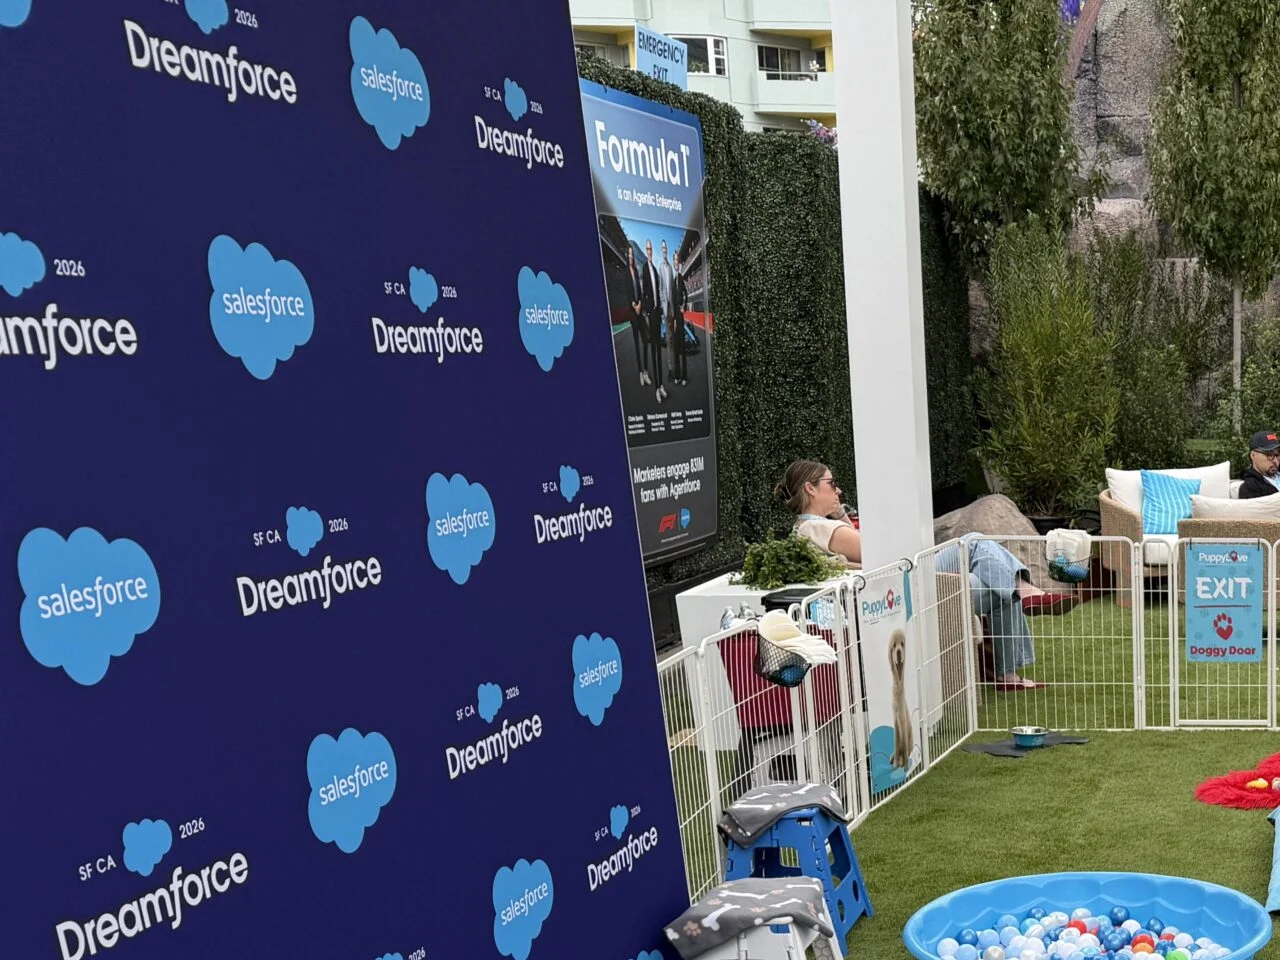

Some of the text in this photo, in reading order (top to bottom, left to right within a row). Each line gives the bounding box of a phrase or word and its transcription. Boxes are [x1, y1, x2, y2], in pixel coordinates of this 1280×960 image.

[235, 9, 258, 28] 2026
[124, 20, 296, 104] Dreamforce
[638, 32, 685, 65] EMERGENCY
[360, 64, 423, 102] salesforce
[653, 64, 668, 82] EXIT
[492, 89, 501, 101] CA
[530, 101, 543, 114] 2026
[474, 116, 563, 169] Dreamforce
[595, 120, 680, 185] Formula
[617, 185, 682, 211] is an Agentic Enterprise
[54, 259, 86, 277] 2026
[222, 287, 305, 323] salesforce
[384, 282, 458, 298] SF CA 2026
[525, 304, 570, 330] salesforce
[0, 303, 138, 370] mforce
[371, 316, 483, 364] Dreamforce
[550, 482, 557, 492] CA
[583, 476, 594, 486] 2026
[633, 467, 666, 484] Marketers
[667, 462, 690, 479] engage
[640, 479, 701, 503] fans with Agentforce
[254, 517, 349, 546] SF CA 2026
[435, 508, 490, 538] salesforce
[533, 502, 613, 544] Dreamforce
[37, 575, 148, 619] salesforce
[236, 555, 382, 617] Dreamforce
[1196, 577, 1252, 599] EXIT
[1190, 646, 1256, 657] Doggy Door
[579, 660, 618, 688] salesforce
[457, 686, 520, 720] SF CA 2026
[446, 714, 542, 780] Dreamforce
[319, 760, 389, 806] salesforce
[630, 805, 641, 818] 2026
[79, 818, 205, 880] SF CA 2026
[587, 826, 658, 891] Dreamforce
[500, 882, 549, 926] salesforce
